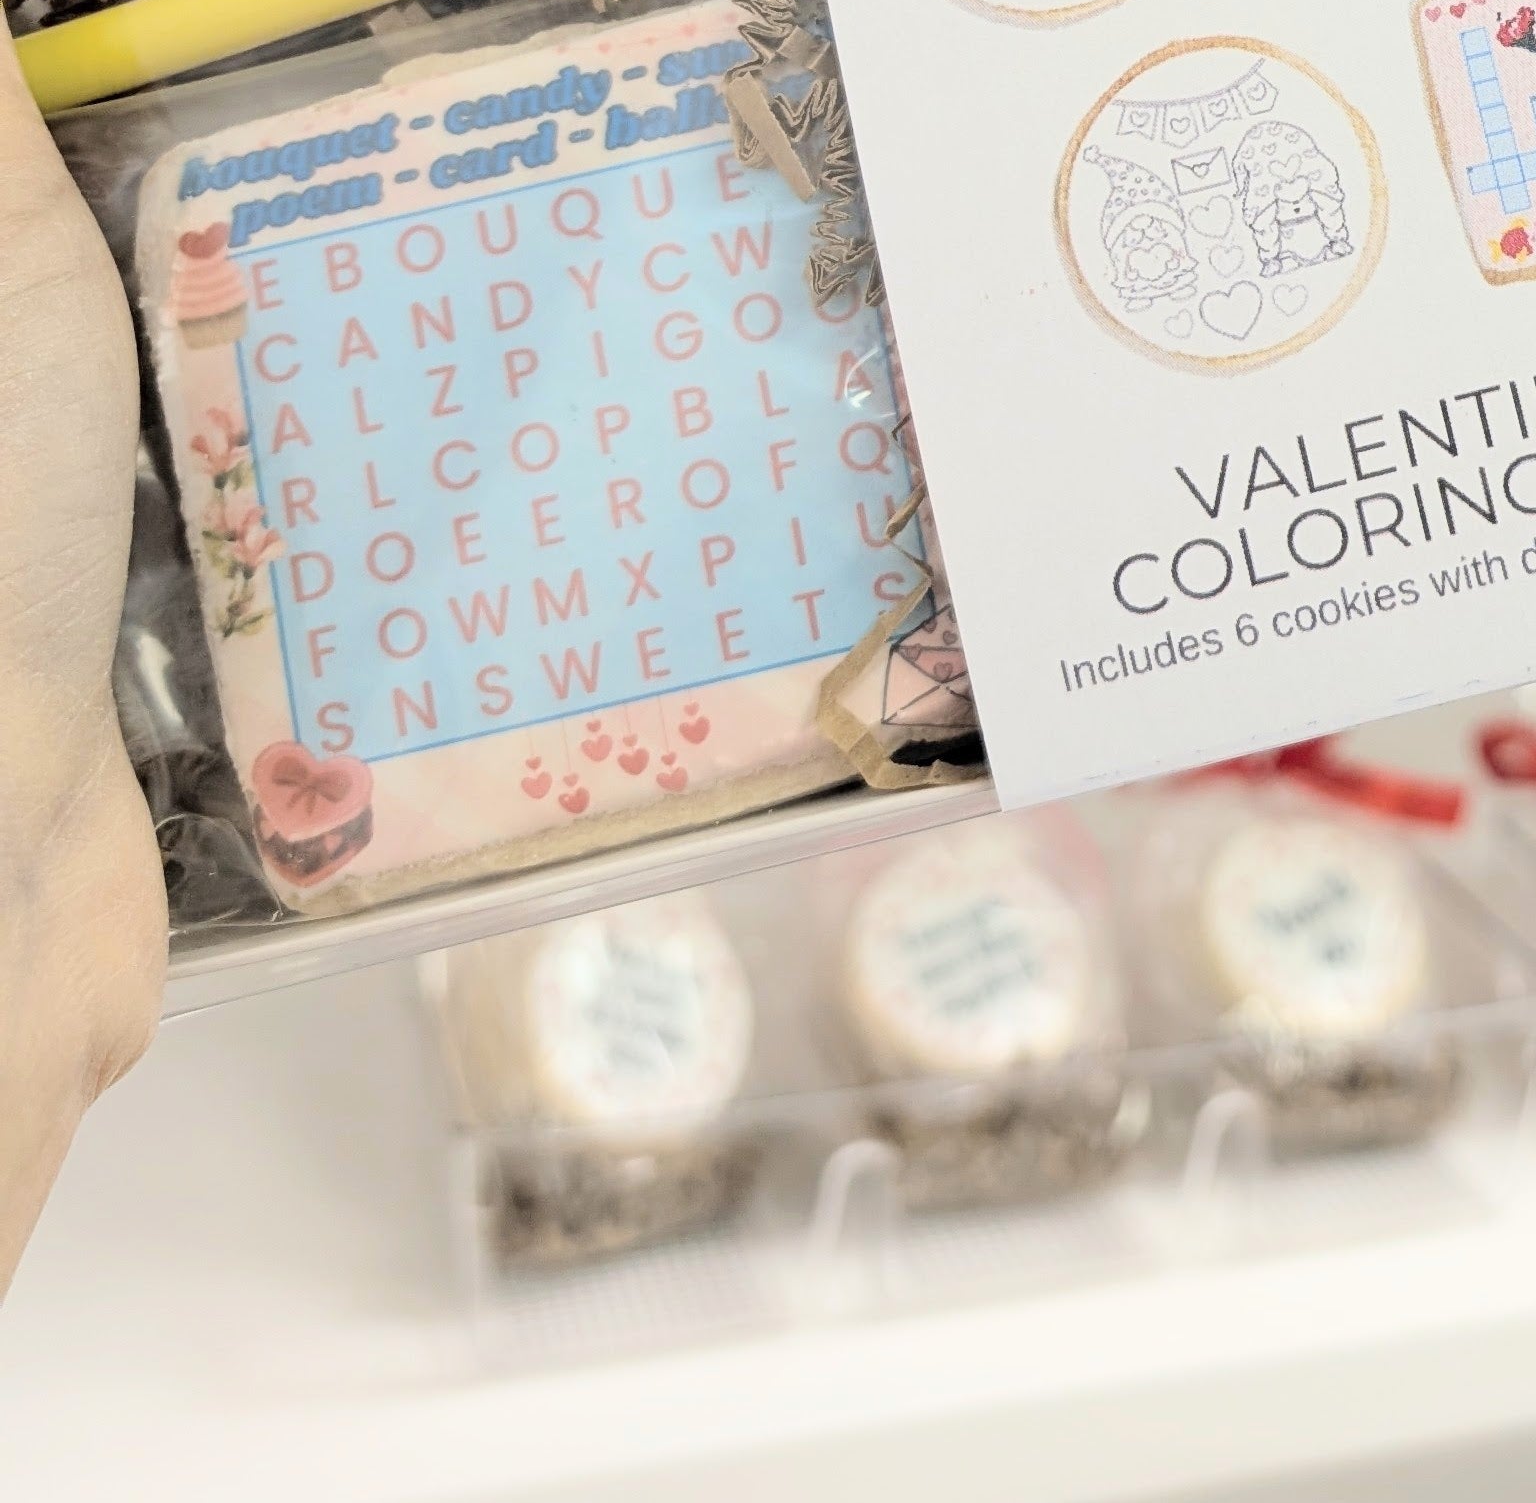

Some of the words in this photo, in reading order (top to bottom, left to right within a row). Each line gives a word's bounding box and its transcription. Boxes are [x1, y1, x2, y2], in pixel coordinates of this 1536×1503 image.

[178, 112, 400, 201] bouquet
[443, 65, 613, 135] candy
[227, 172, 383, 248] poem
[429, 119, 559, 189] card
[604, 83, 730, 149] ball
[252, 259, 284, 310] E
[323, 242, 364, 294] B
[395, 223, 447, 275] O
[475, 204, 518, 257] U
[549, 187, 604, 241] Q
[632, 168, 675, 220] U
[716, 153, 749, 202] E
[254, 333, 302, 384] C
[337, 316, 379, 368] A
[409, 295, 456, 350] N
[487, 279, 535, 333] D
[566, 259, 603, 311] Y
[641, 242, 691, 295] C
[710, 223, 772, 276] W
[272, 403, 313, 454] A
[352, 386, 384, 436] L
[424, 363, 464, 419] Z
[502, 346, 540, 400] P
[653, 311, 704, 363] G
[732, 292, 784, 344] O
[281, 476, 320, 528] R
[363, 461, 396, 511] L
[430, 439, 481, 493] C
[508, 421, 560, 475] O
[594, 403, 632, 456] P
[671, 385, 714, 439] B
[756, 369, 790, 418] L
[289, 551, 335, 604] D
[364, 530, 416, 586] O
[451, 511, 487, 567] E
[530, 494, 566, 549] E
[605, 477, 647, 530] R
[678, 457, 731, 512] O
[767, 439, 797, 493] F
[838, 420, 893, 474] Q
[306, 624, 337, 679] F
[375, 607, 428, 661] O
[447, 585, 510, 644] W
[532, 568, 589, 626] M
[618, 551, 662, 607] X
[698, 533, 736, 588] P
[316, 700, 354, 753] S
[392, 680, 438, 736] N
[474, 663, 514, 717] S
[539, 641, 601, 700] W
[634, 626, 671, 682] E
[713, 607, 751, 664] E
[791, 588, 825, 642] T
[1060, 627, 1224, 692] Includes
[1235, 612, 1260, 647] 6
[1271, 578, 1420, 638] cookies
[1428, 549, 1509, 597] with
